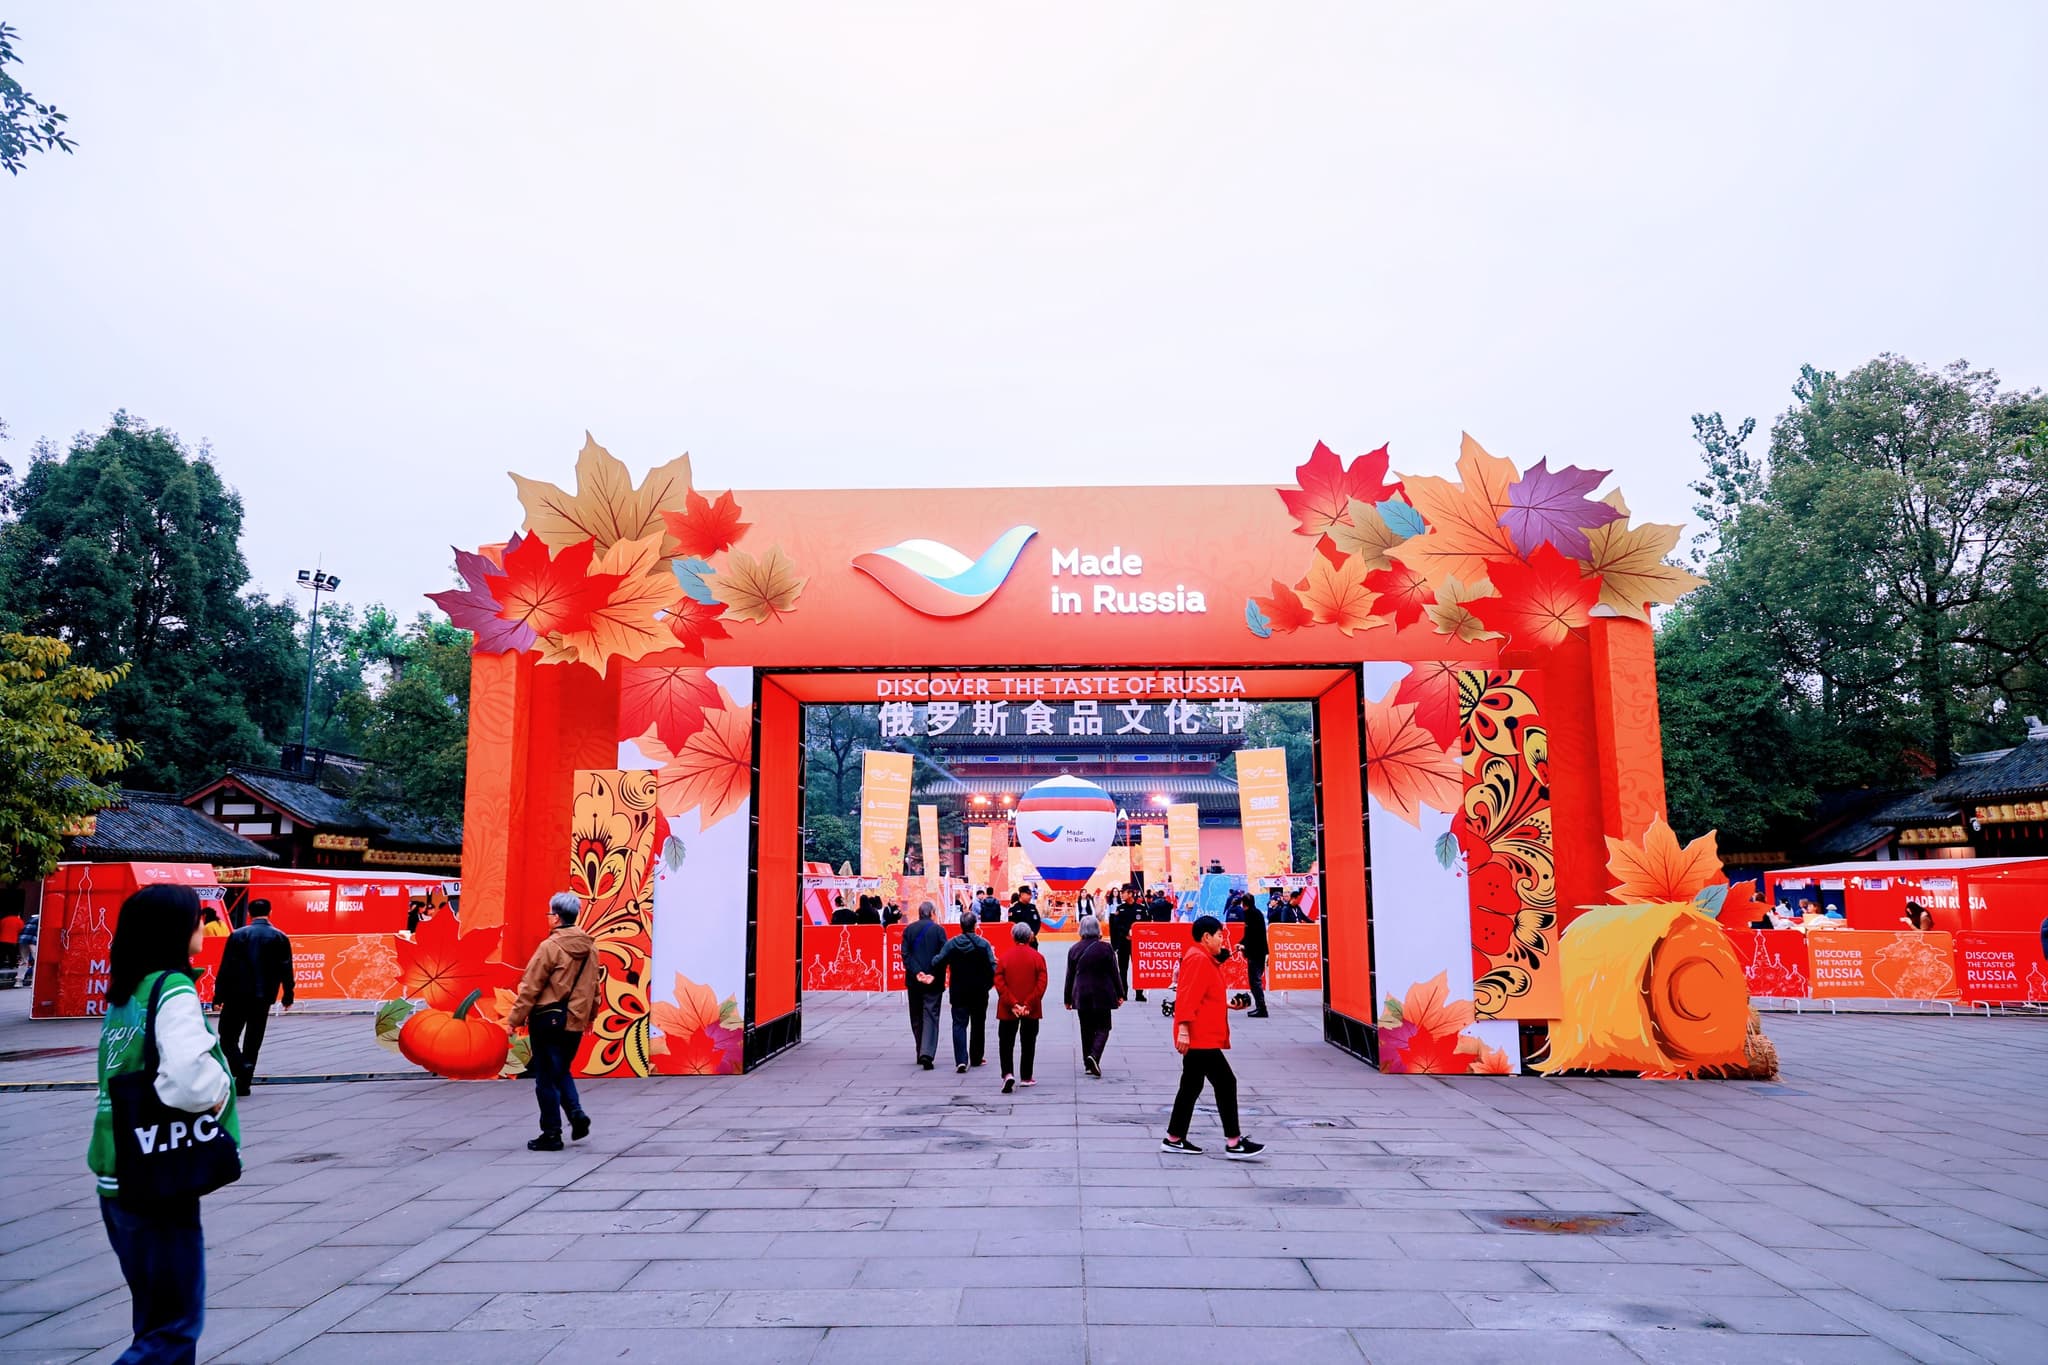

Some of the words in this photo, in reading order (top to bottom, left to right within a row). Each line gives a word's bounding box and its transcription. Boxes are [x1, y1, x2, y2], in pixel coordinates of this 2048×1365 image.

[1051, 547, 1143, 576] Made
[1052, 585, 1082, 614] in
[1093, 585, 1206, 614] Russia
[877, 679, 990, 696] DISCOVER
[1001, 678, 1044, 695] THE
[1051, 677, 1119, 694] TASTE
[1126, 677, 1156, 694] OF
[1163, 676, 1246, 693] RUSSIA
[878, 698, 1247, 737] 俄罗斯食品文化节
[306, 901, 329, 912] MADE
[1935, 896, 1947, 908] IN
[1948, 896, 1987, 910] RUSIA
[1138, 941, 1181, 950] DISCOVER
[1274, 943, 1318, 951] DISCOVER
[292, 953, 325, 961] SCOVER
[1814, 949, 1862, 958] DISCOVER
[1965, 951, 2014, 960] DISCOVER
[1139, 960, 1180, 970] RUSSIA
[1275, 960, 1318, 971] RUSSIA
[1816, 967, 1864, 979] RUSSIA
[1967, 970, 2017, 981] RUSSIA
[88, 979, 108, 994] IN
